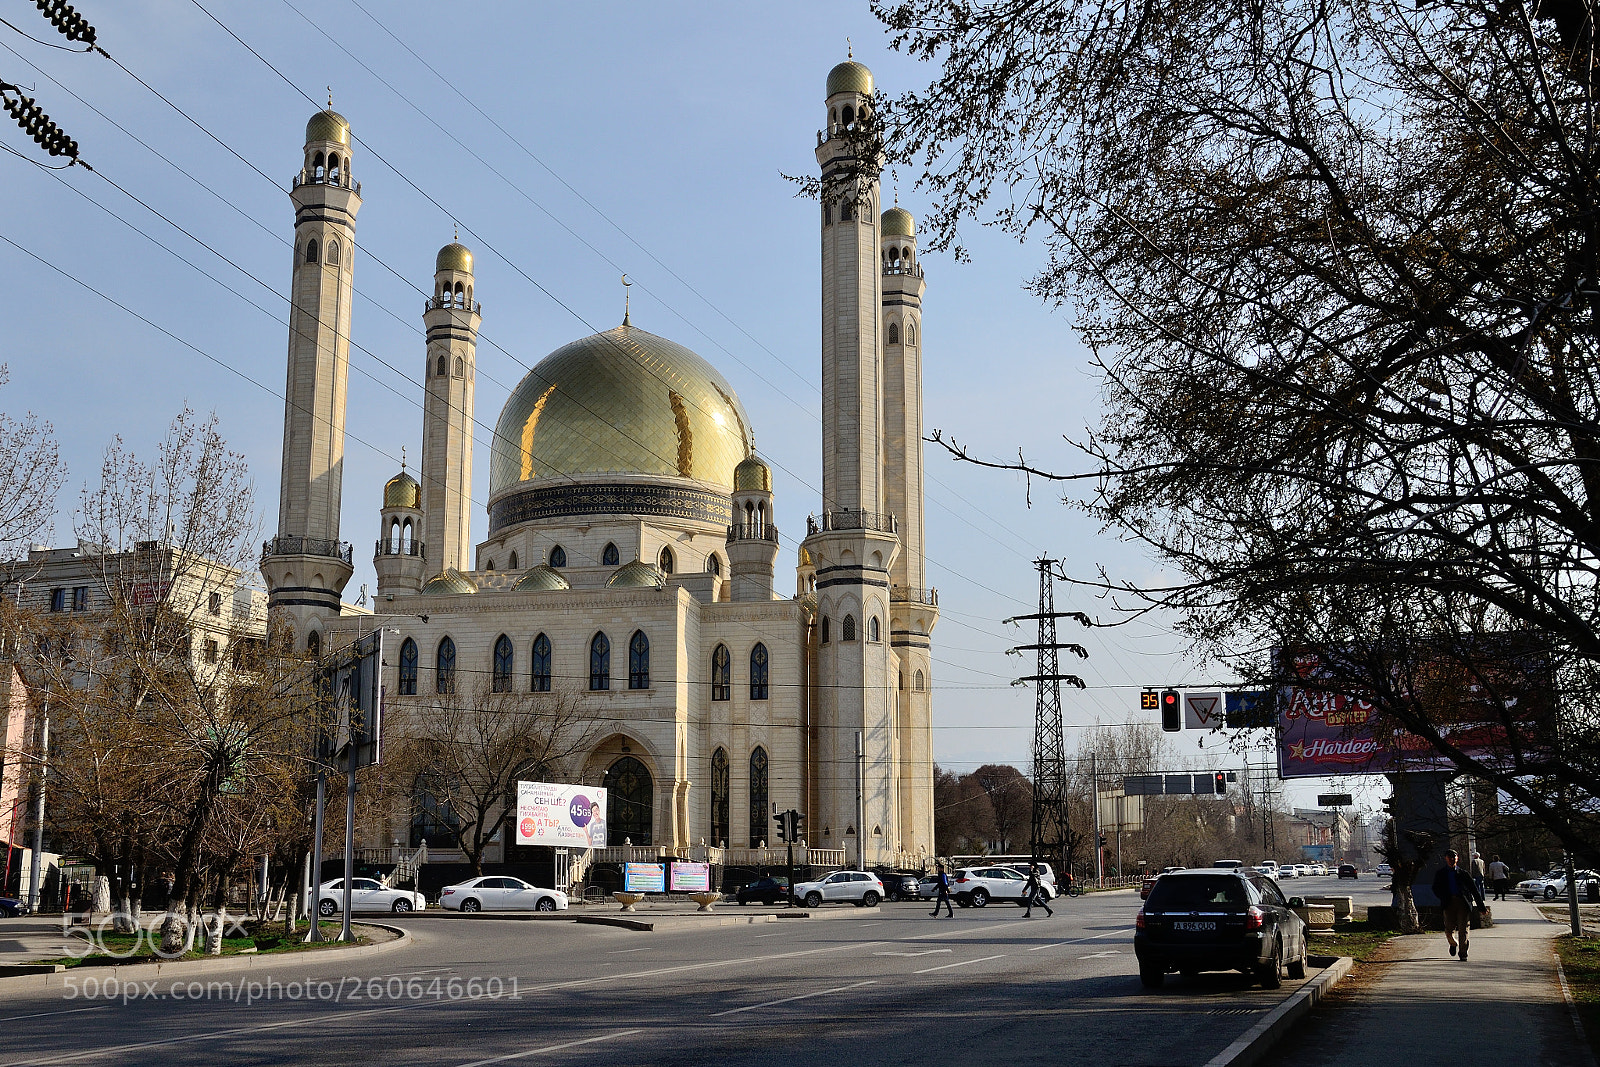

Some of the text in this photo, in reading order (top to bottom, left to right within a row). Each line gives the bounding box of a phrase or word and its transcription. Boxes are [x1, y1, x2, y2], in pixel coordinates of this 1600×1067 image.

[1142, 694, 1158, 708] 35
[534, 797, 567, 807] СЕН ШЕ?
[544, 819, 560, 828] ТЫ?
